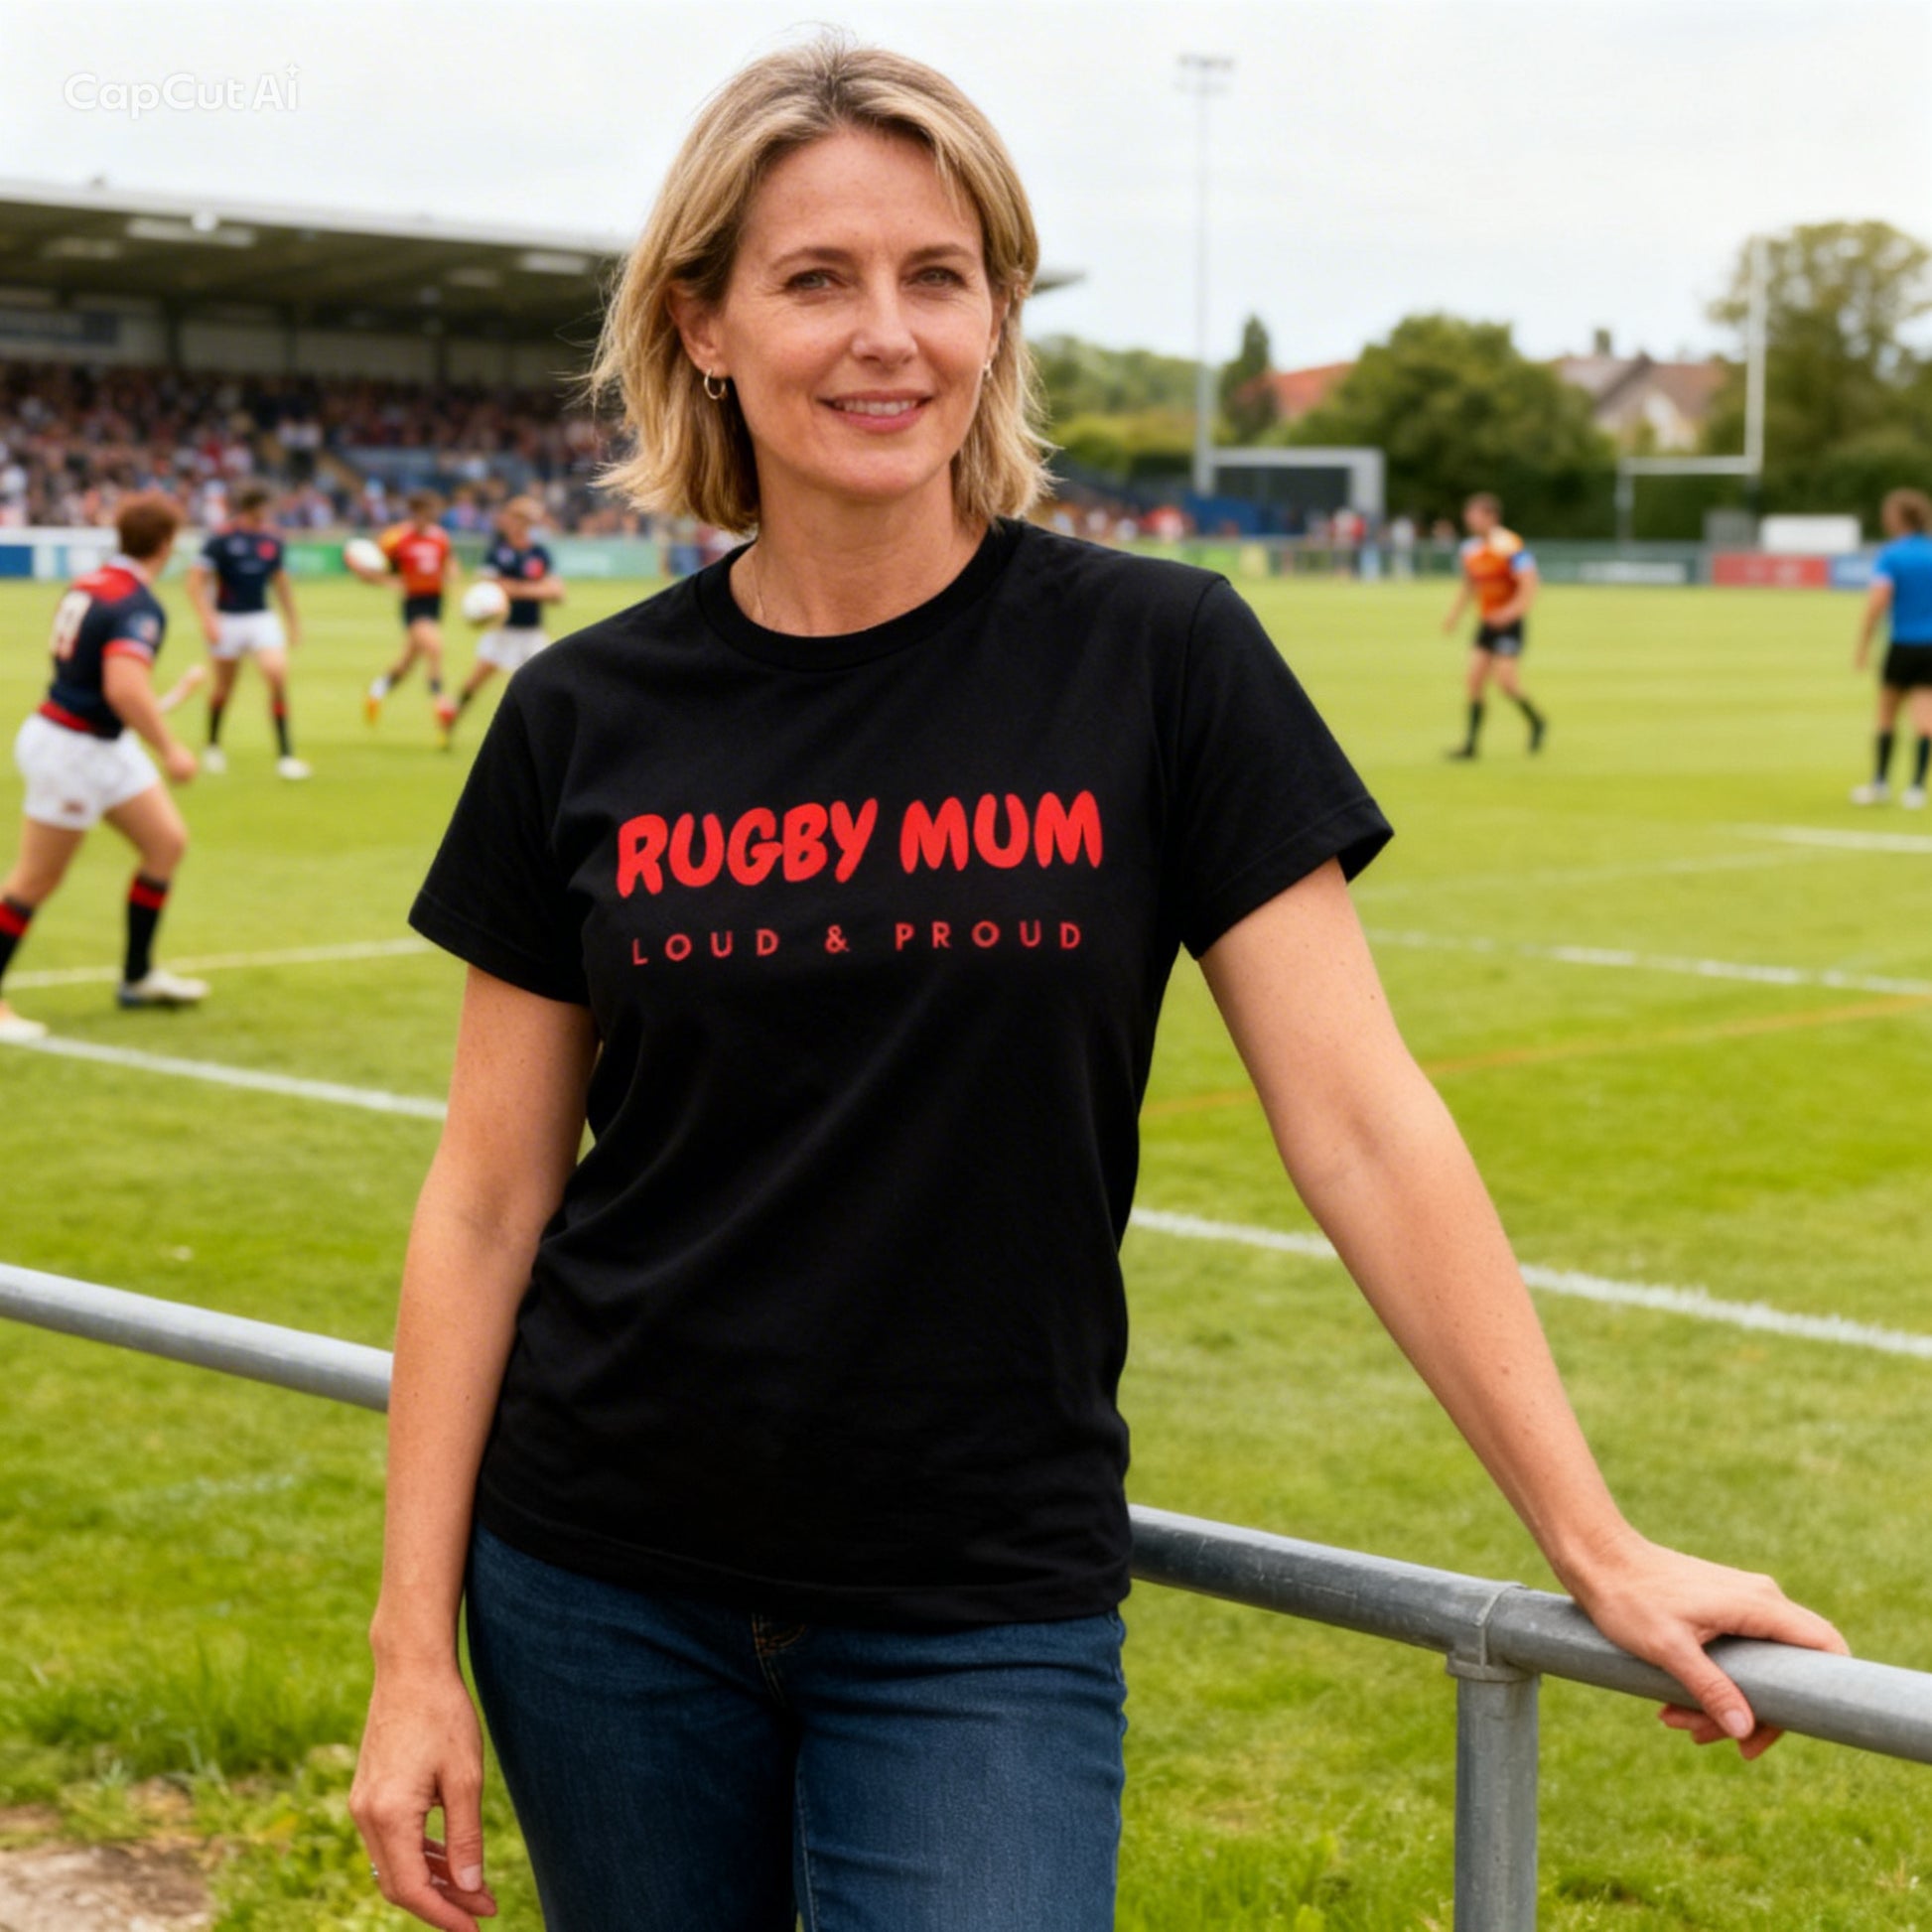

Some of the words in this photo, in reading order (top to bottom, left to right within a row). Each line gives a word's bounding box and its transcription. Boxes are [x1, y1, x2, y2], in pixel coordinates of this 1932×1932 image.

[616, 797, 879, 898] RUGBY
[898, 790, 1103, 874] MUM
[631, 928, 779, 966] LOUD
[824, 924, 850, 954] &
[894, 920, 1082, 951] PROUD
